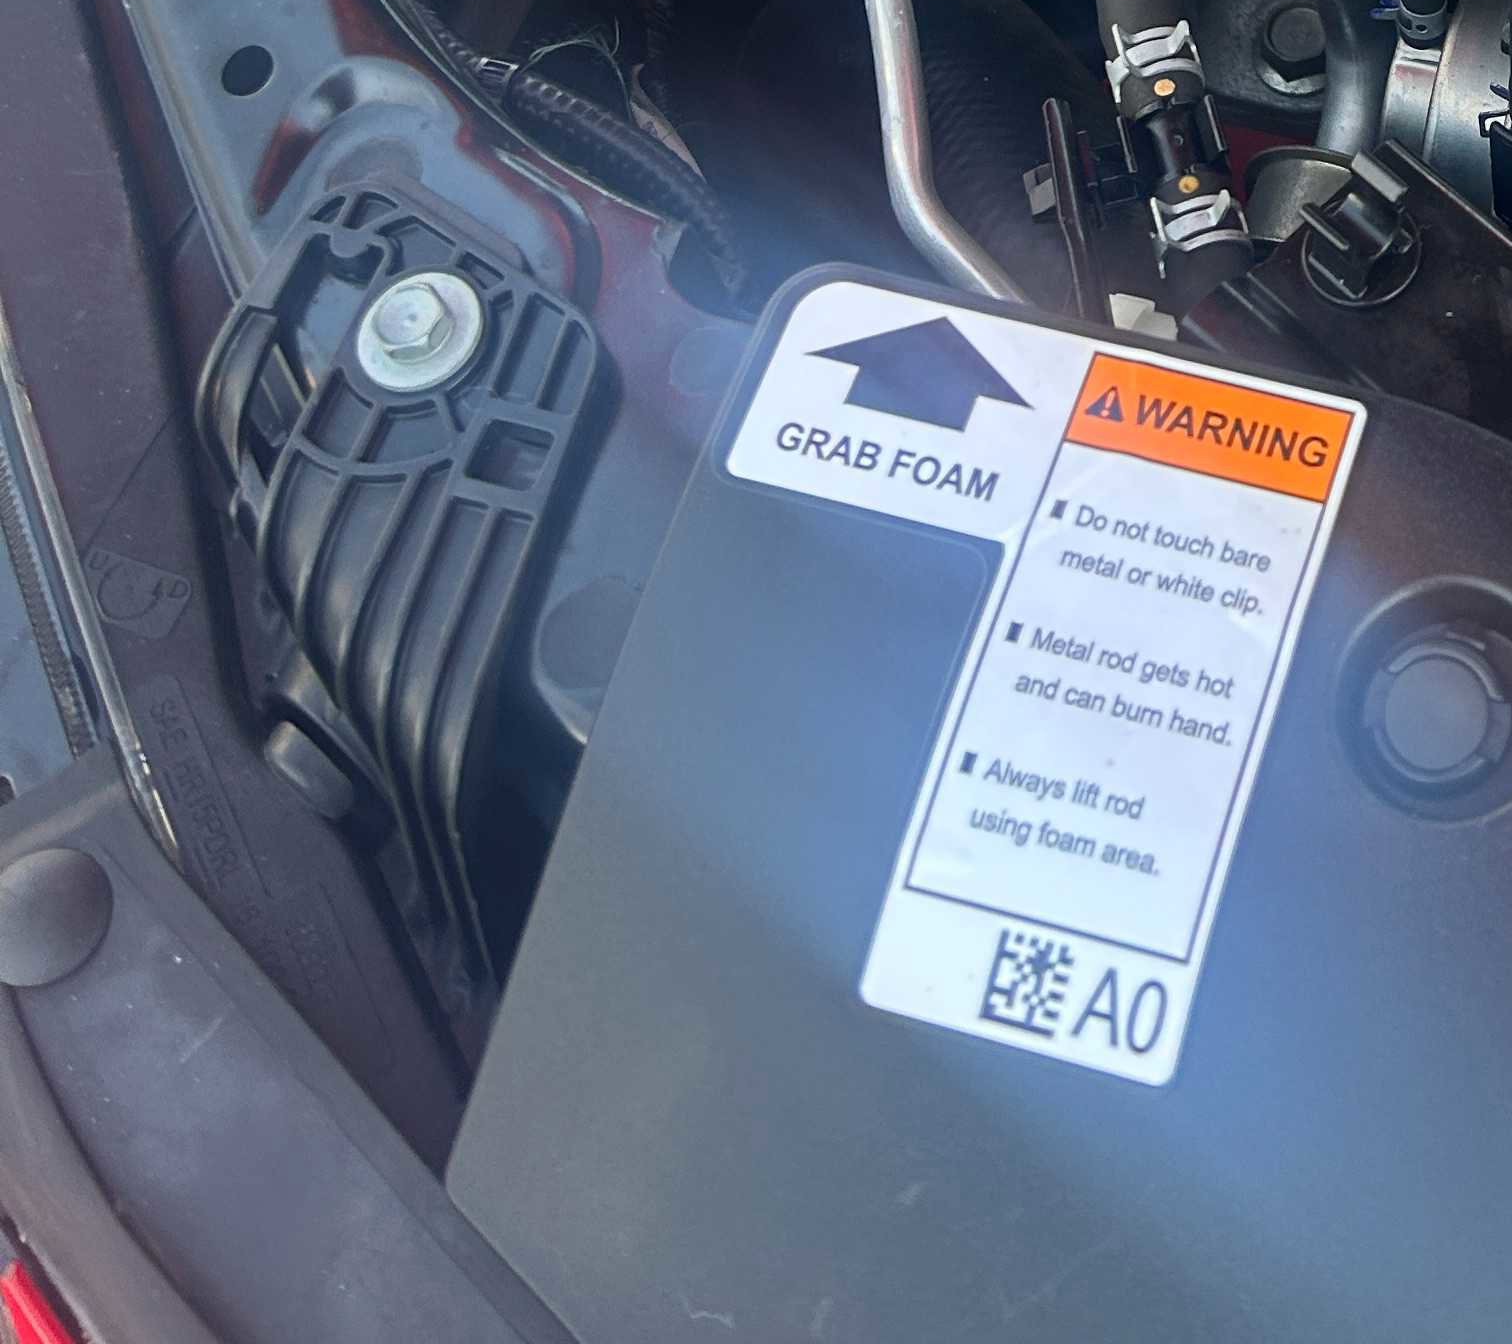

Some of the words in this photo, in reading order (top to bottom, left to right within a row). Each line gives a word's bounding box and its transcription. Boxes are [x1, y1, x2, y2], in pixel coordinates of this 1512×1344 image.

[775, 422, 883, 472] GRAB
[887, 448, 1001, 503] FOAM
[1135, 393, 1330, 468] WARNING
[1074, 503, 1108, 532] Do
[1111, 516, 1150, 543] not
[1153, 525, 1216, 562] touch
[1219, 540, 1272, 574] bare
[1059, 547, 1125, 580] metal
[1126, 565, 1153, 587] or
[1157, 570, 1216, 604] white
[1219, 588, 1264, 618] clip.
[1029, 626, 1096, 663] Metal
[1097, 647, 1138, 674] rod
[1138, 660, 1192, 689] gets
[1195, 668, 1236, 700] hot
[1014, 673, 1062, 701] and
[1063, 685, 1107, 713] can
[1110, 693, 1163, 729] burn
[1167, 708, 1232, 747] hand.
[983, 757, 1067, 801] Always
[1070, 778, 1101, 809] lift
[1104, 792, 1146, 821] rod
[968, 807, 1032, 847] using
[1037, 820, 1097, 859] foam
[1100, 840, 1161, 877] area.
[1070, 965, 1169, 1056] A0
